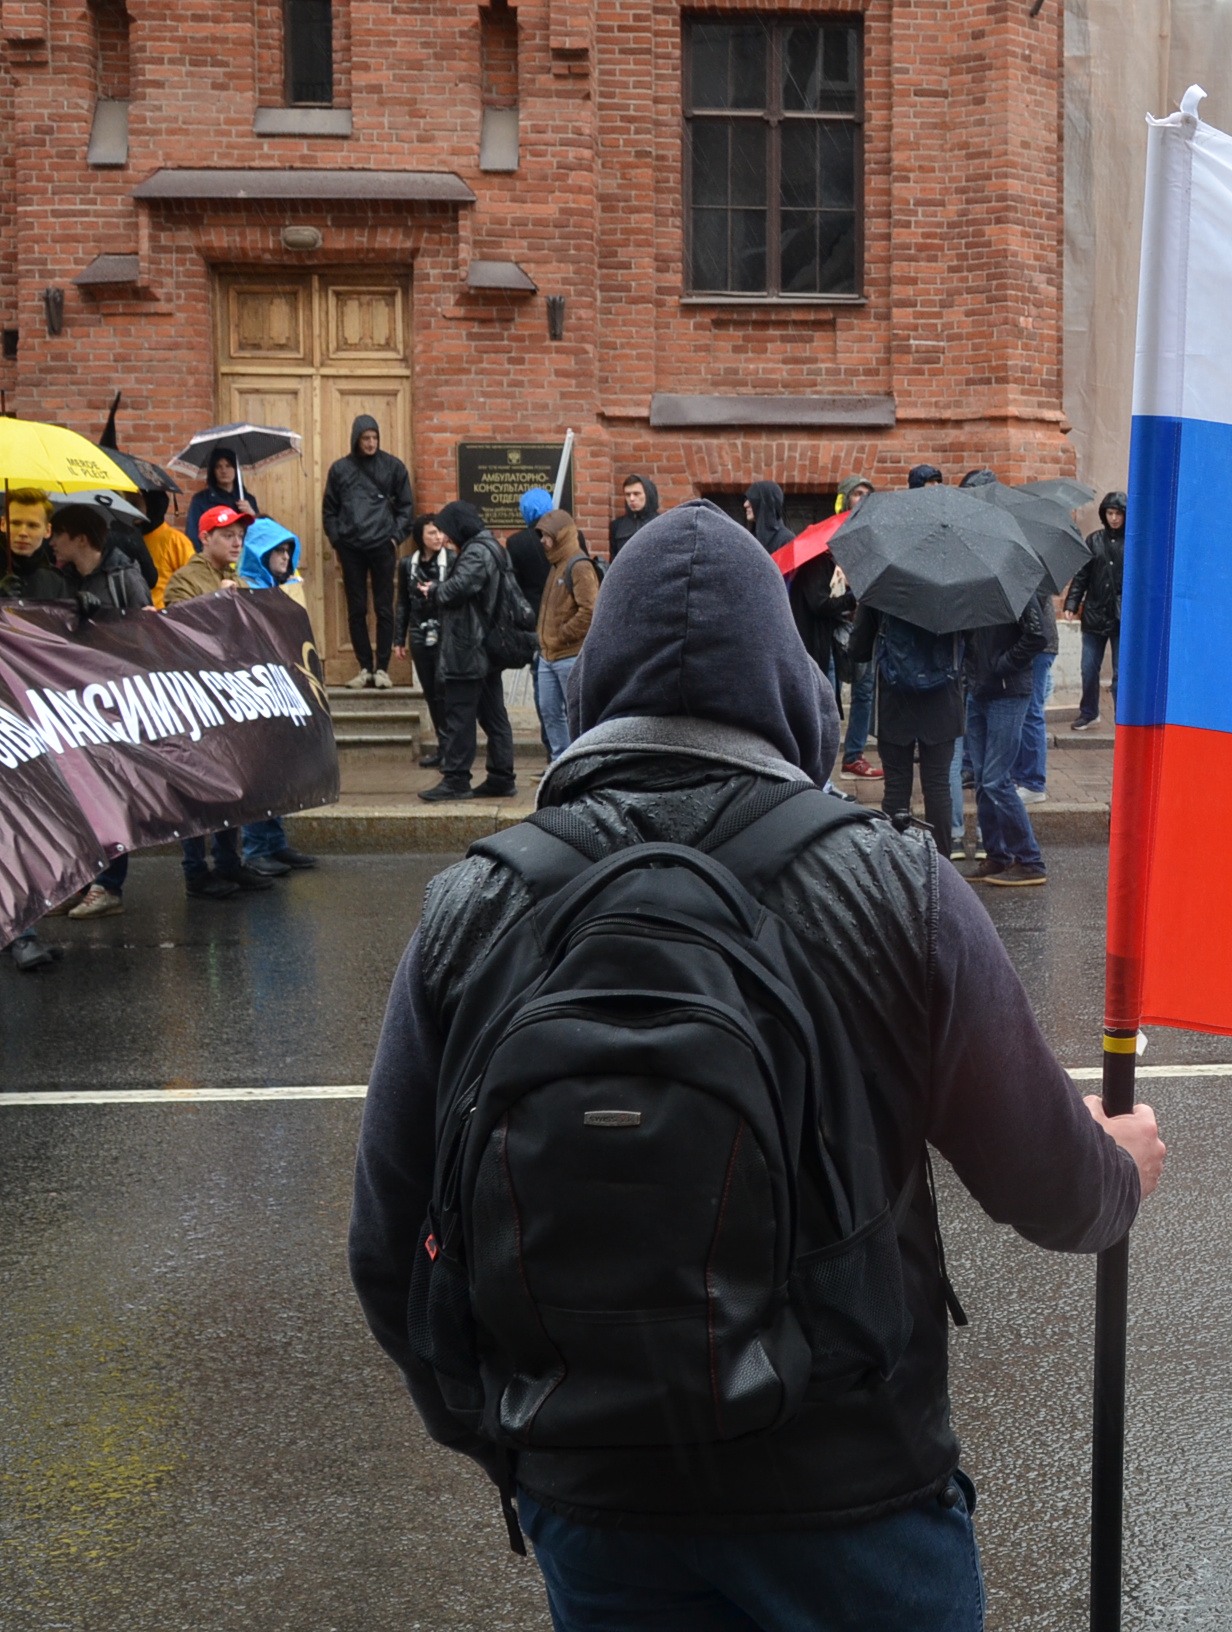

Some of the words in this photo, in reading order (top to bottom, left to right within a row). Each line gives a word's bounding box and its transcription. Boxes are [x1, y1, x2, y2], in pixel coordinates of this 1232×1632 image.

[481, 472, 549, 482] АМБУЛАТОРНО-
[490, 493, 522, 504] ОТДЕЛ
[25, 669, 225, 755] МАКСИМУМ
[198, 662, 313, 727] СВОБОДЫ
